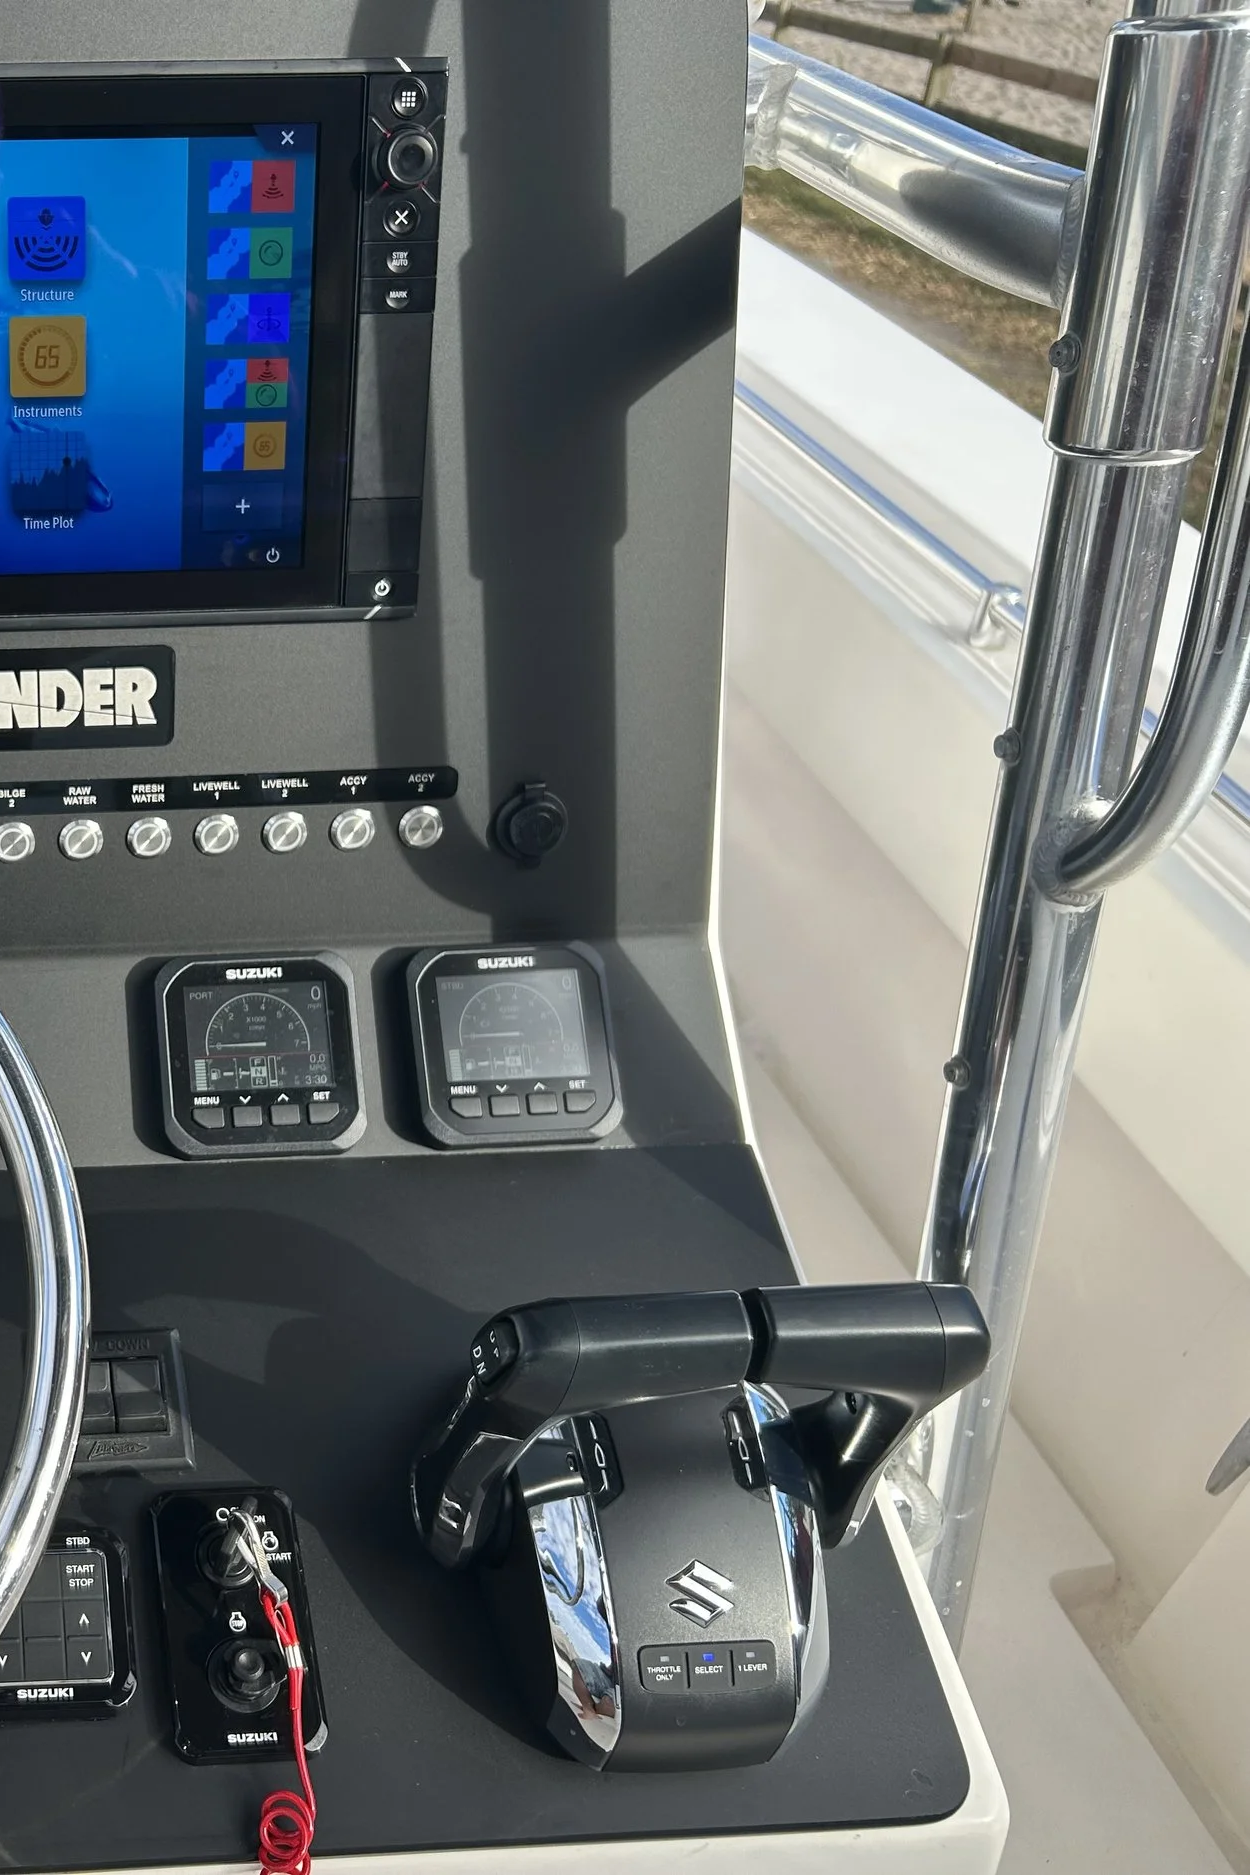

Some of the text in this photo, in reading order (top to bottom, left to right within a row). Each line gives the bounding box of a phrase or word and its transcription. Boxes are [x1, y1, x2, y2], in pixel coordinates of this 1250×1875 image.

[392, 251, 408, 259] STBY
[392, 258, 408, 266] AUTO
[20, 288, 74, 302] Structure
[389, 290, 407, 298] MARK
[13, 405, 82, 419] Instruments
[23, 516, 74, 531] Time Plot
[193, 780, 240, 792] LIVEWELL
[261, 778, 309, 789] LIVEWELL
[418, 783, 424, 793] 2
[68, 786, 91, 796] RAW
[132, 784, 165, 794] FRESH
[282, 788, 288, 798] 2
[351, 785, 356, 795] 1
[131, 793, 165, 803] WATER
[214, 791, 219, 800] 1
[9, 799, 15, 808] 2
[63, 796, 97, 806] WATER
[477, 956, 534, 970] SUZUKI
[225, 966, 283, 980] SUZUKI
[189, 991, 213, 1001] PORT
[310, 985, 321, 1001] 0
[243, 1003, 249, 1012] 3
[259, 1002, 266, 1011] 4
[228, 1012, 234, 1021] 2
[294, 1039, 301, 1048] 7
[254, 1058, 262, 1066] F
[254, 1066, 263, 1076] N
[255, 1077, 264, 1086] R
[305, 1075, 328, 1086] 3:30
[568, 1080, 586, 1090] SET
[450, 1085, 476, 1095] MENU
[193, 1096, 220, 1106] MENU
[312, 1091, 330, 1101] SET
[65, 1537, 90, 1546] STBD
[266, 1552, 292, 1561] START
[66, 1564, 95, 1574] START
[69, 1578, 94, 1587] STOP
[647, 1665, 681, 1674] THROTTLE
[694, 1665, 724, 1674] SELECT
[738, 1664, 768, 1672] 1 LEVER
[16, 1688, 74, 1700] SUZUKI
[227, 1732, 278, 1744] SUZUKI
